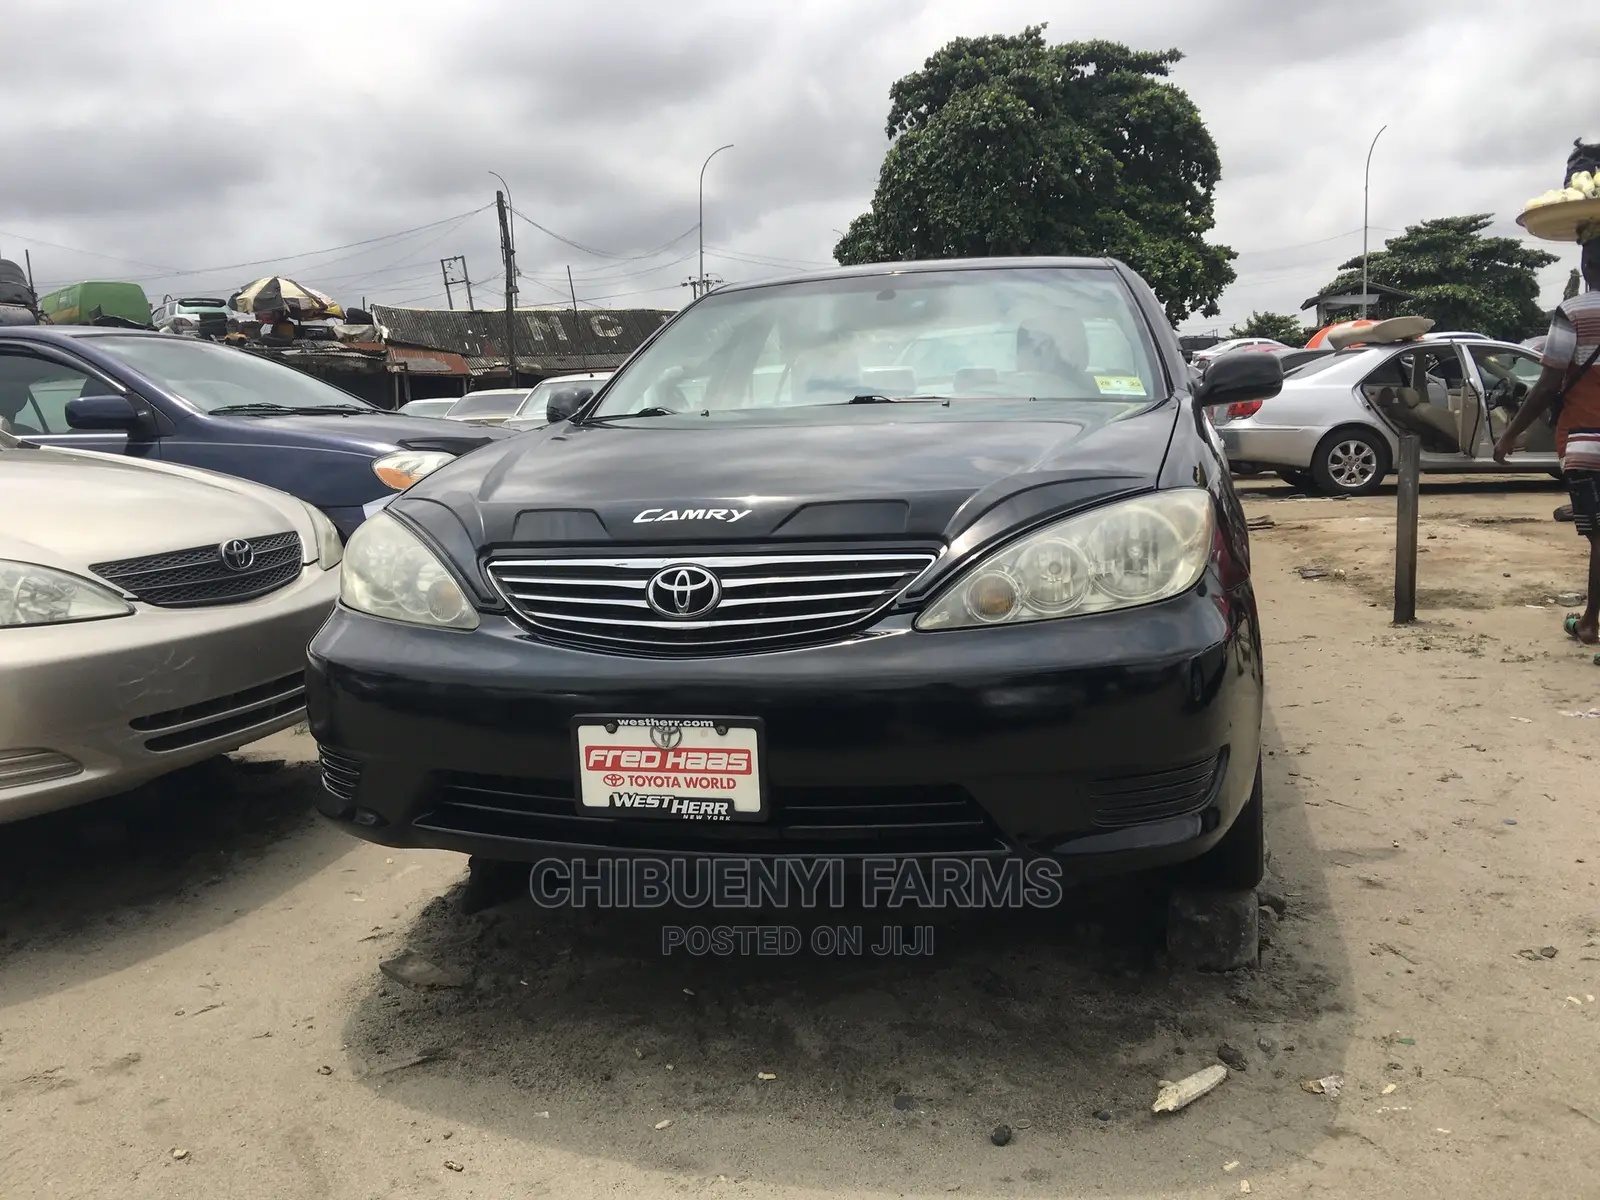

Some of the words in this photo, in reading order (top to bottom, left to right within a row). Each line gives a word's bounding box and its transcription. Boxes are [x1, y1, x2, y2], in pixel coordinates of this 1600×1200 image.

[632, 508, 753, 524] CAMRY
[617, 718, 714, 728] westherr.com
[627, 775, 682, 788] TOYOTA
[684, 776, 737, 790] WORLD
